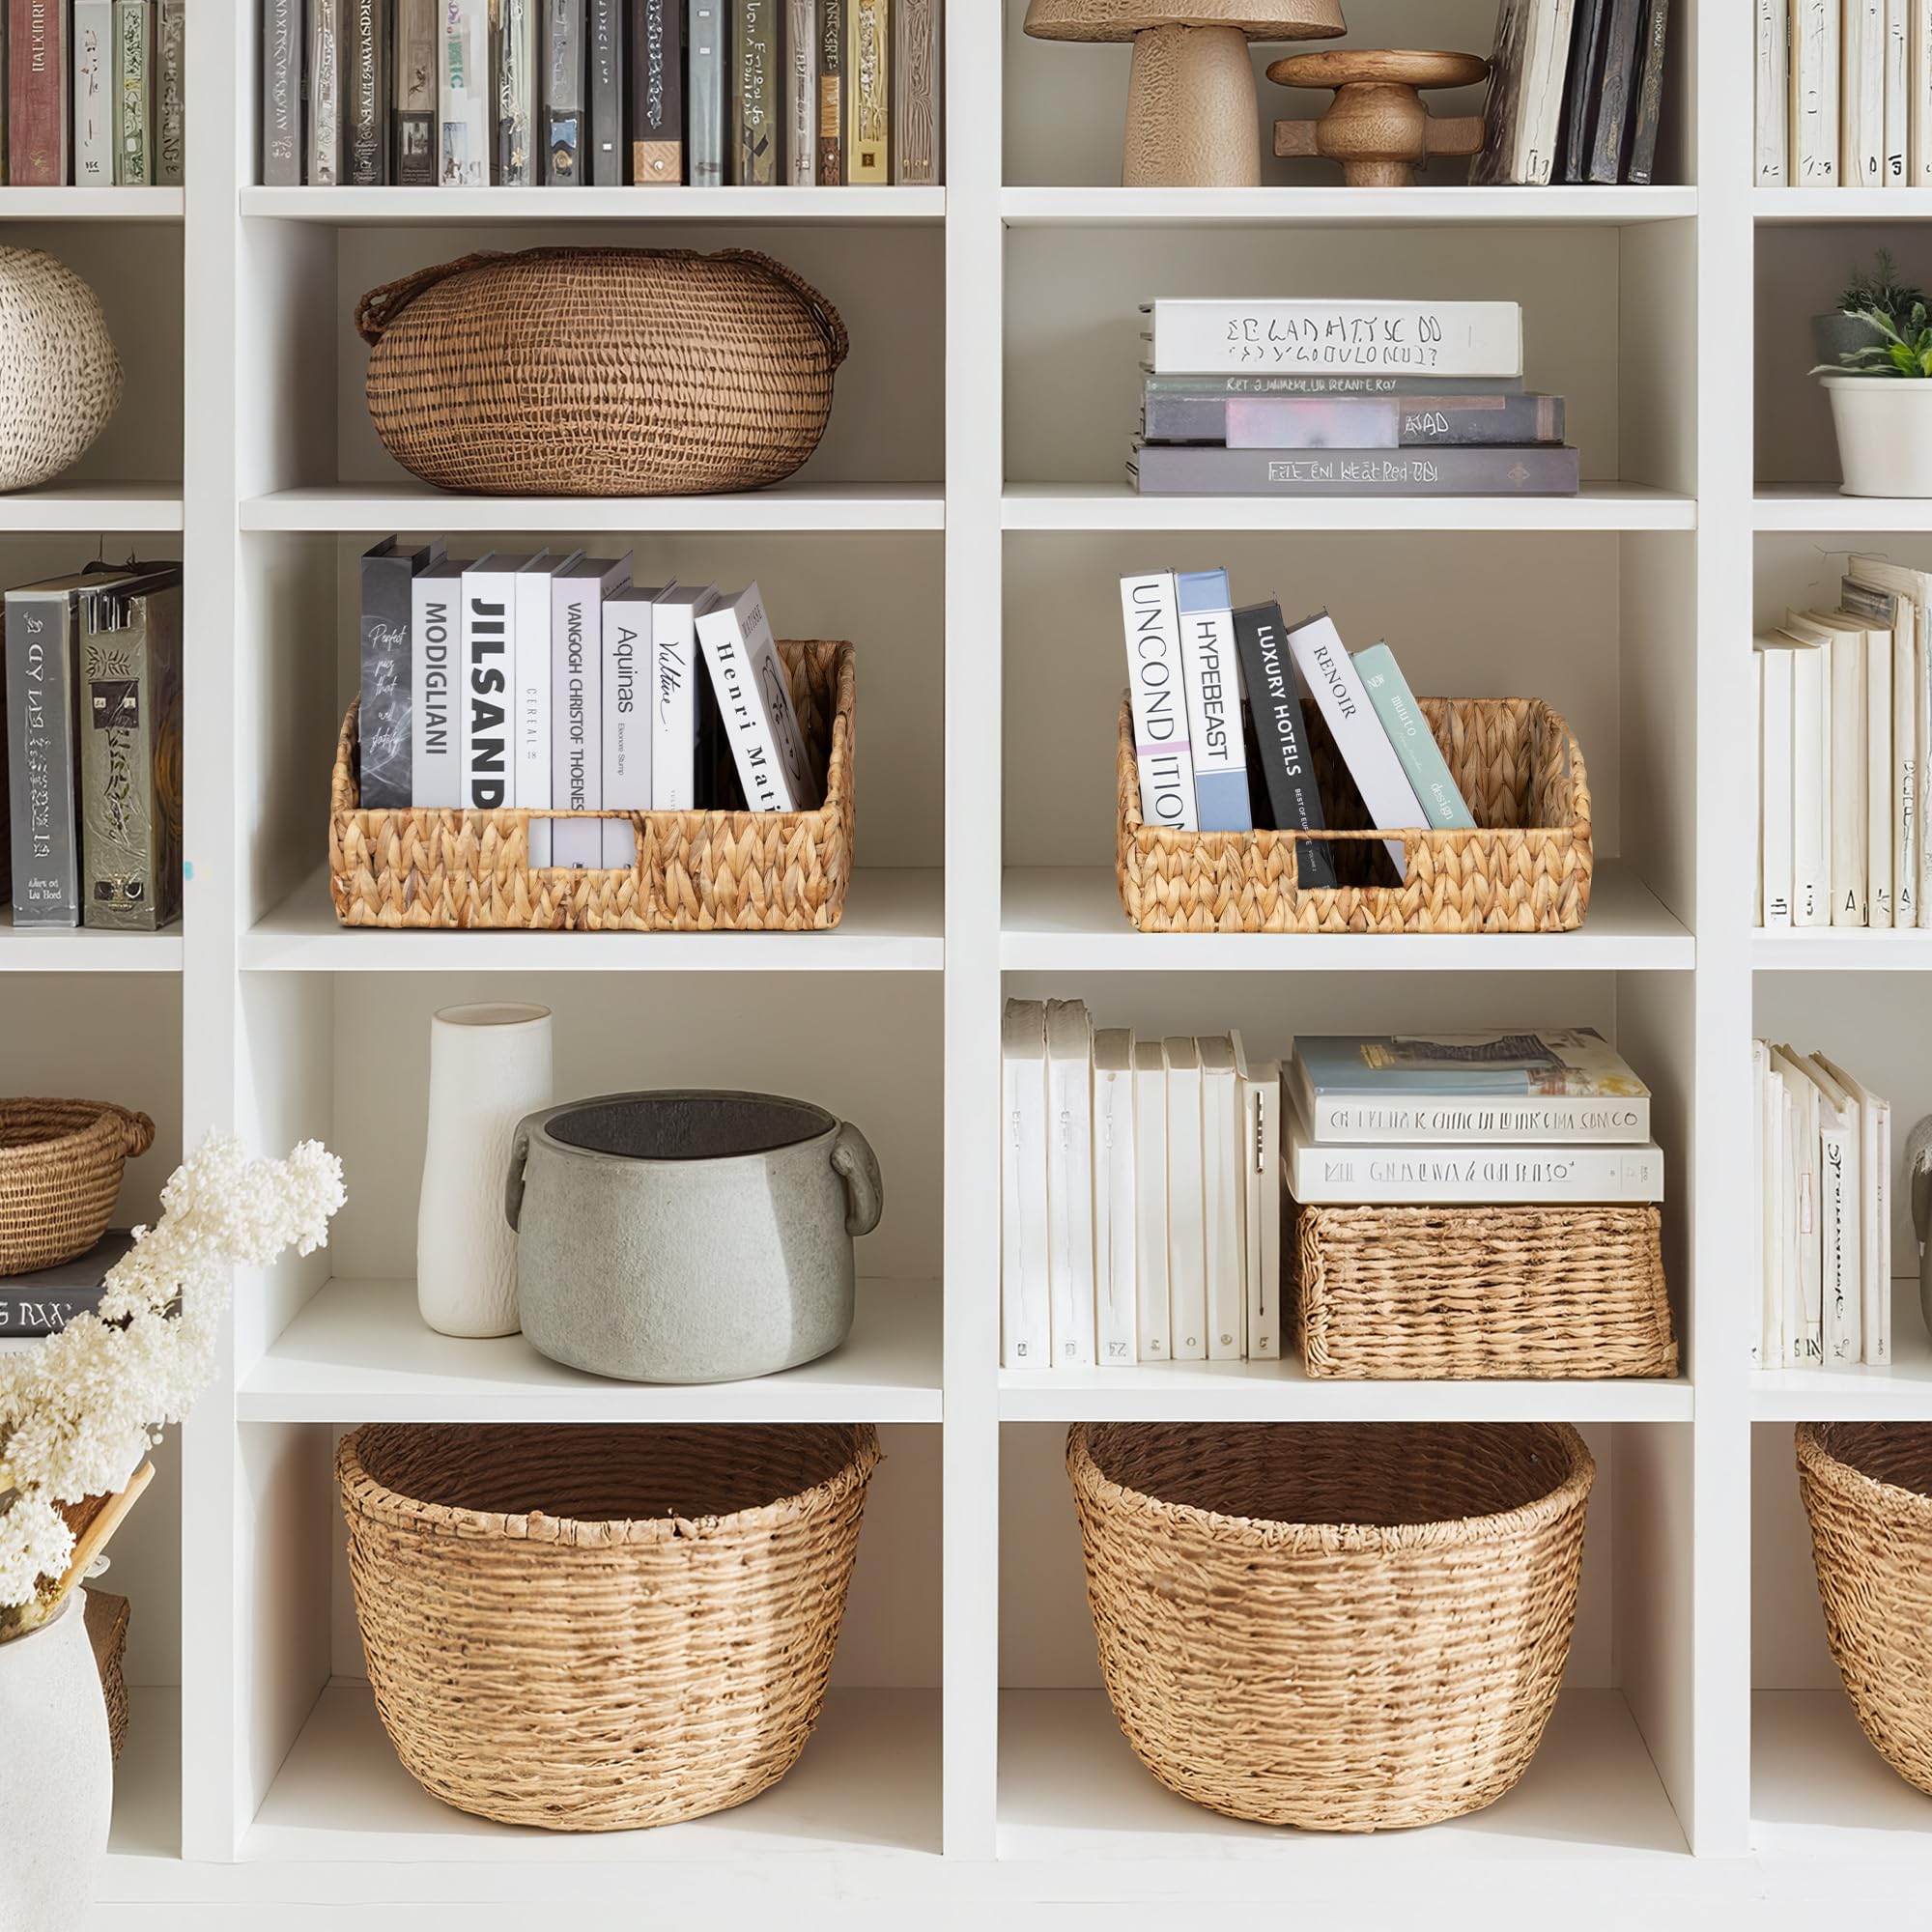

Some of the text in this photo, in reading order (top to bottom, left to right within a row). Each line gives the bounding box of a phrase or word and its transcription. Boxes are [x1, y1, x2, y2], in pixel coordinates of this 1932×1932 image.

[425, 603, 447, 754] MODIGLIANI
[470, 598, 504, 810] JILSAND
[567, 603, 584, 810] VANGOGH CHRISTOF THOENES
[612, 626, 638, 713] Aquinas
[716, 641, 756, 731] Henri
[1196, 620, 1228, 761] HYPEBEAST
[1257, 626, 1302, 777] LUXURY HOTELS
[1314, 645, 1356, 719] RENOIR
[526, 688, 537, 743] CEREAL
[1294, 788, 1303, 806] BEST
[1298, 807, 1306, 815] OF
[1431, 781, 1454, 819] design
